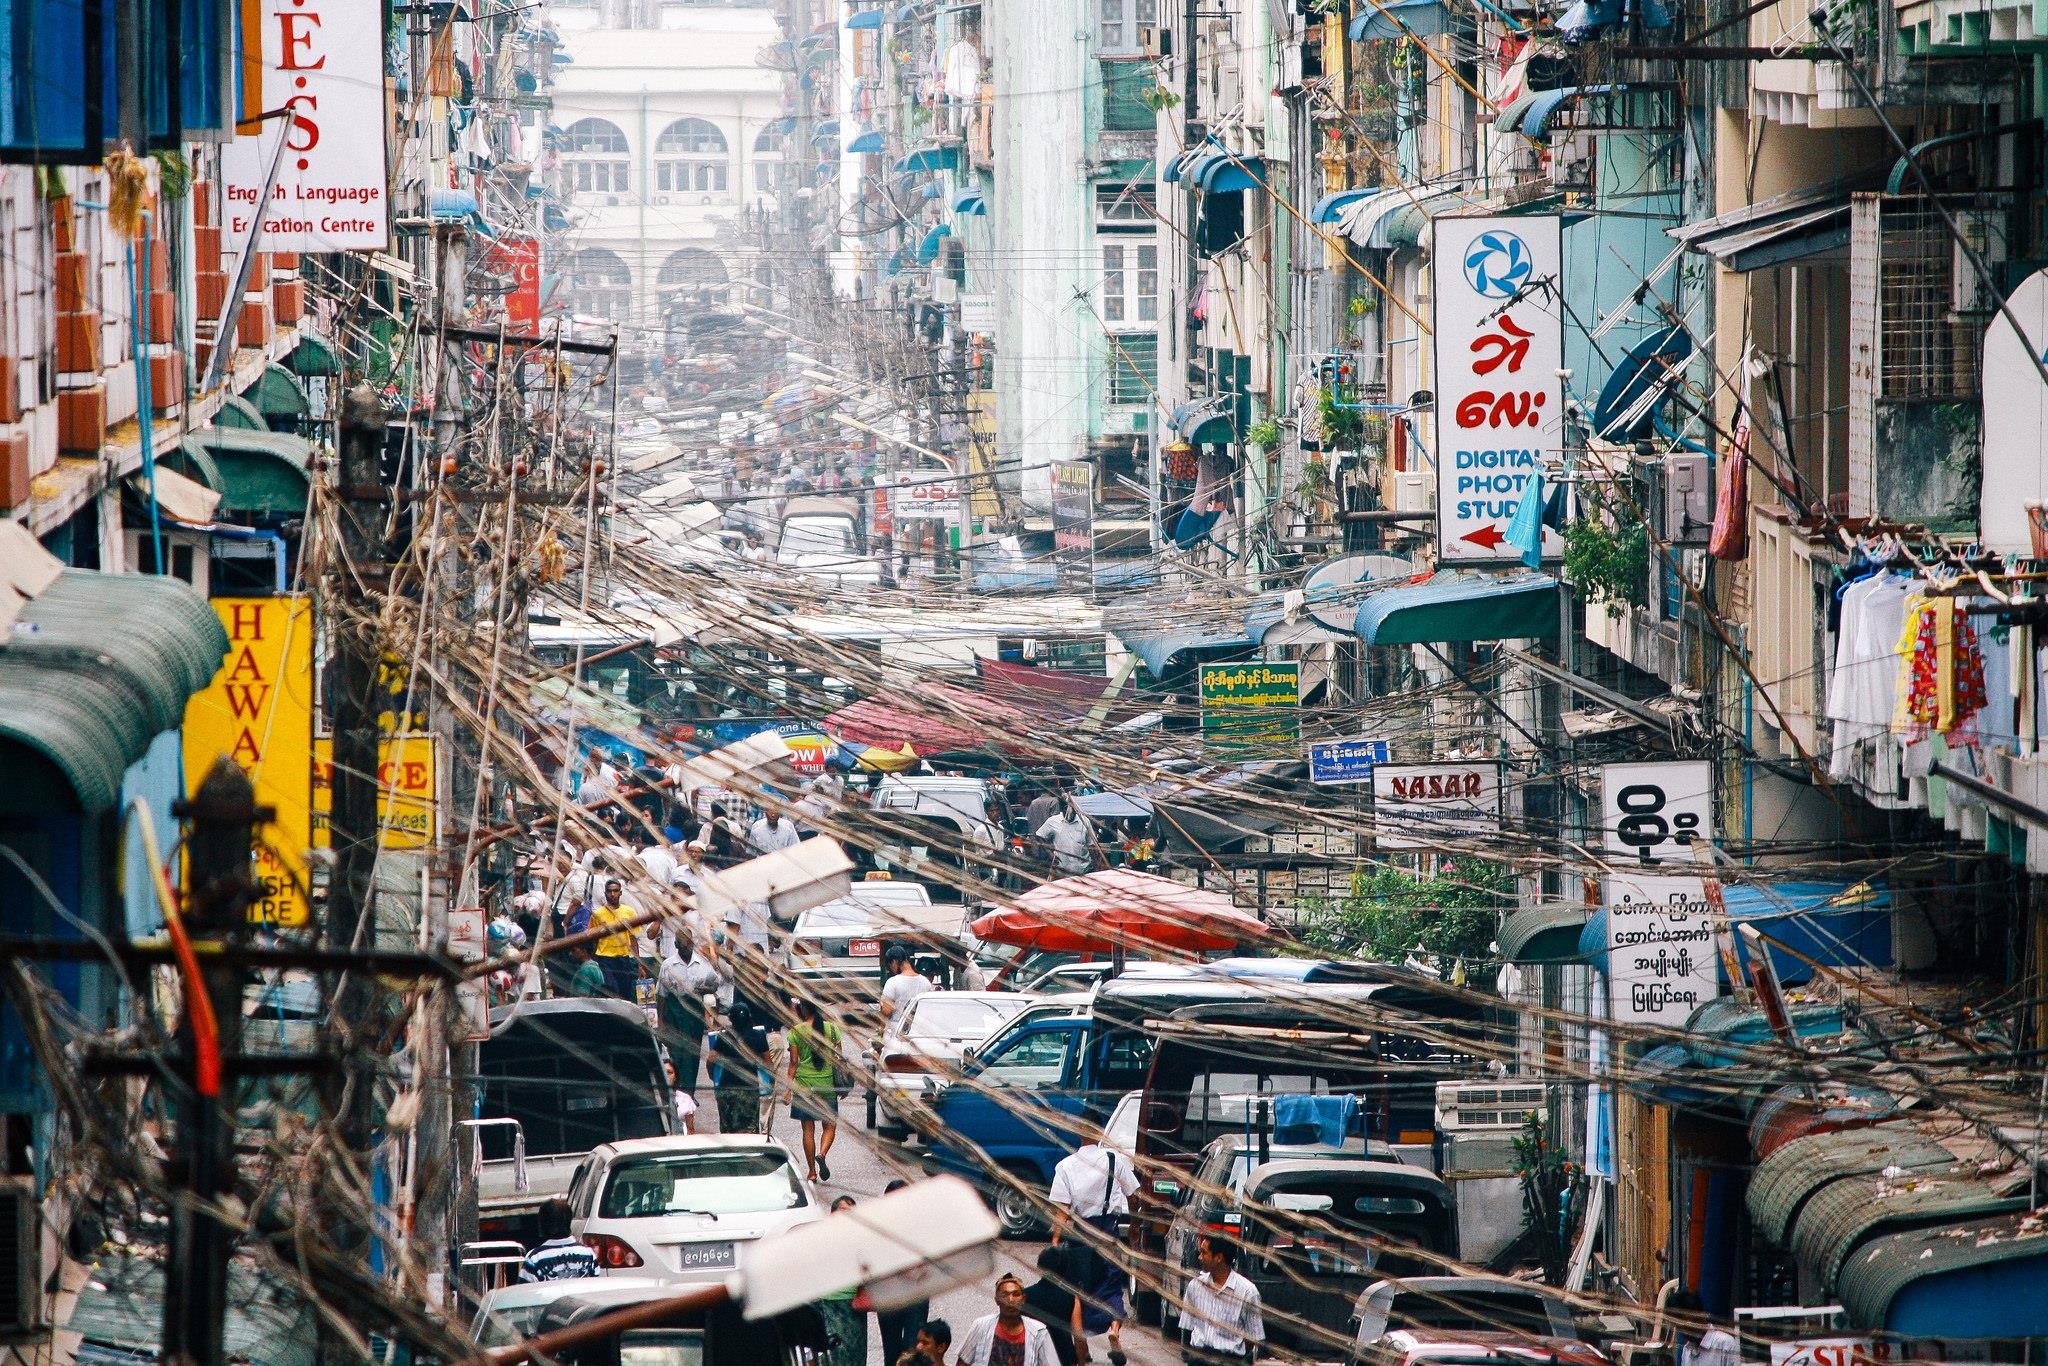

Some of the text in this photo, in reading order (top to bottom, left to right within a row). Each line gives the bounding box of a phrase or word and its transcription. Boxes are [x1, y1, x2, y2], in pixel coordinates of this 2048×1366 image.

[228, 184, 379, 204] Engh Language
[321, 215, 375, 232] Centre
[1456, 390, 1546, 429] လေး
[1457, 500, 1519, 519] STUD
[224, 603, 271, 776] HAWA
[1391, 772, 1482, 799] NASAR
[245, 899, 294, 920] TRE
